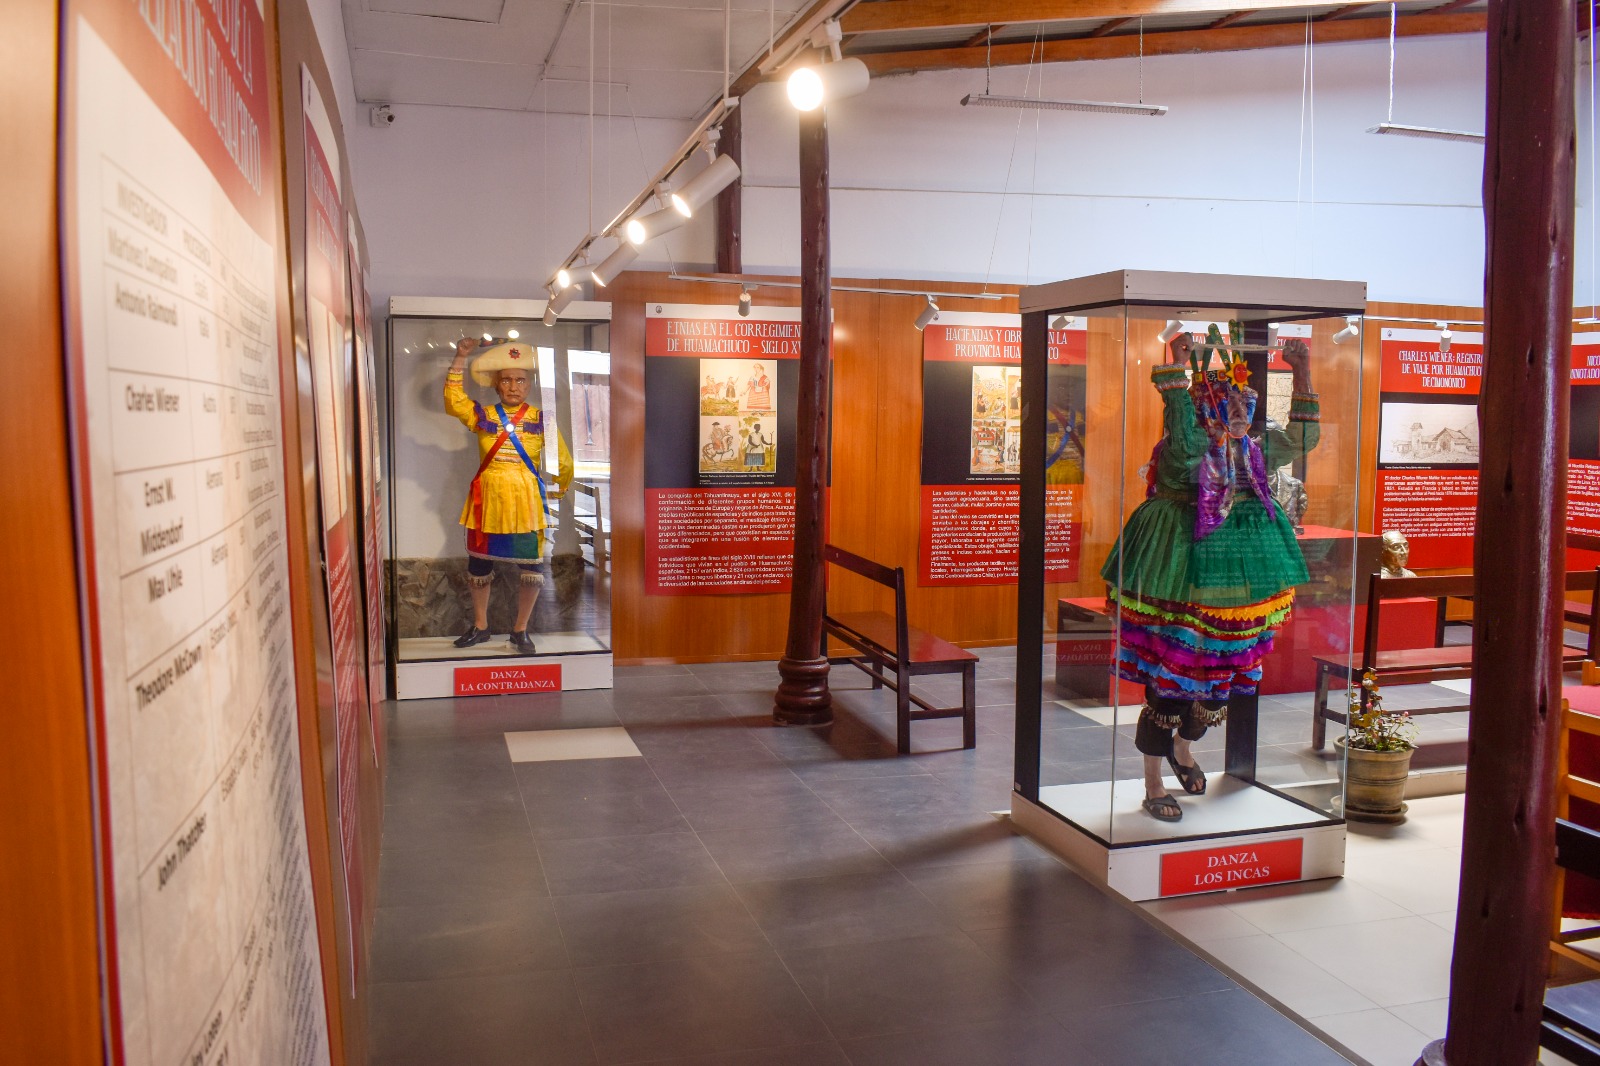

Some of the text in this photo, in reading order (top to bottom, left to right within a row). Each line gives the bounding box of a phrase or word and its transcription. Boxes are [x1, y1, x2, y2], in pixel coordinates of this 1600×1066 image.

[667, 321, 801, 338] ETNIAS EN EL CORREGIMIEN
[945, 328, 994, 342] HACIENDAS
[996, 329, 1003, 342] Y
[1004, 330, 1021, 343] OBR
[1056, 332, 1067, 344] LA
[667, 338, 681, 352] DE
[684, 339, 750, 353] HUAMACHUCO
[761, 340, 789, 354] SIGLO
[955, 343, 1001, 358] PROVINCIA
[1398, 350, 1428, 362] CHARLES
[1429, 351, 1455, 363] WIENER:
[1413, 364, 1429, 375] VIAJE
[1431, 364, 1444, 376] POR
[1422, 376, 1466, 389] DECIMONÓNICO
[125, 384, 154, 412] Charles
[156, 388, 180, 412] Wiener
[148, 575, 166, 603] Max
[490, 670, 526, 680] DANZA
[135, 665, 174, 712] Theodore
[461, 680, 556, 692] LA CONTRADANZA
[1207, 851, 1258, 868] DANZA
[1194, 866, 1270, 886] LOS INCAS
